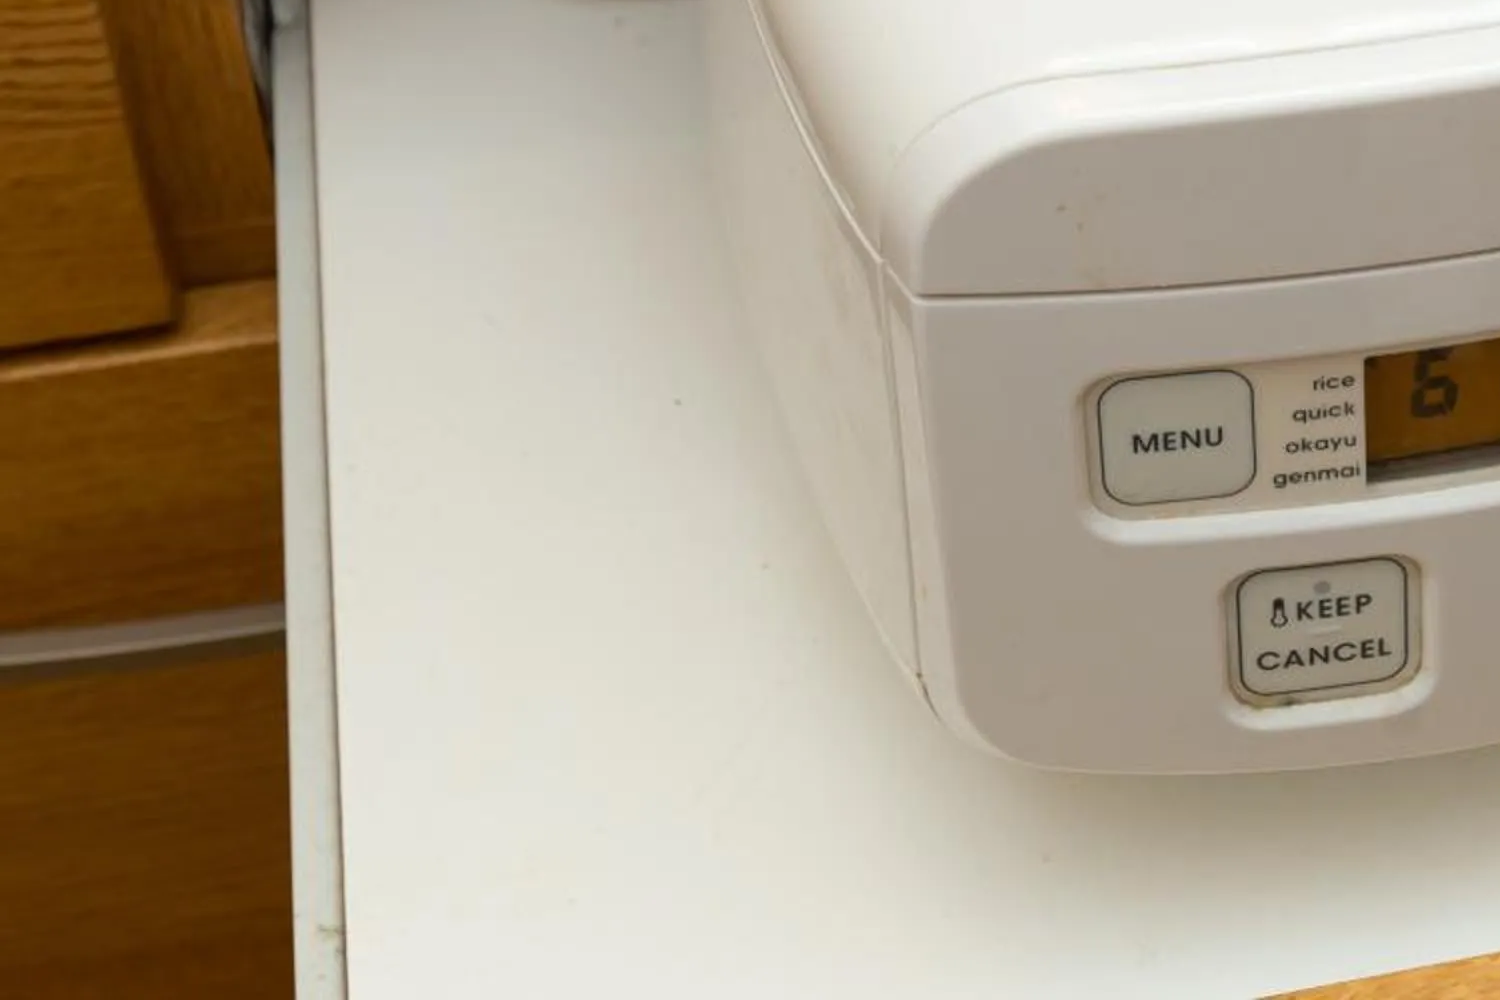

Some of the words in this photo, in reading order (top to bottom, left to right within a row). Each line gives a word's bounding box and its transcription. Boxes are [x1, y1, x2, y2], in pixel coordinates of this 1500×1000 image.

[1312, 374, 1356, 391] rice
[1292, 403, 1355, 424] quick
[1131, 426, 1223, 454] MENU
[1285, 436, 1357, 455] okayu
[1273, 461, 1361, 489] genmai
[1296, 593, 1373, 621] KEEP
[1256, 637, 1392, 671] CANCEL
